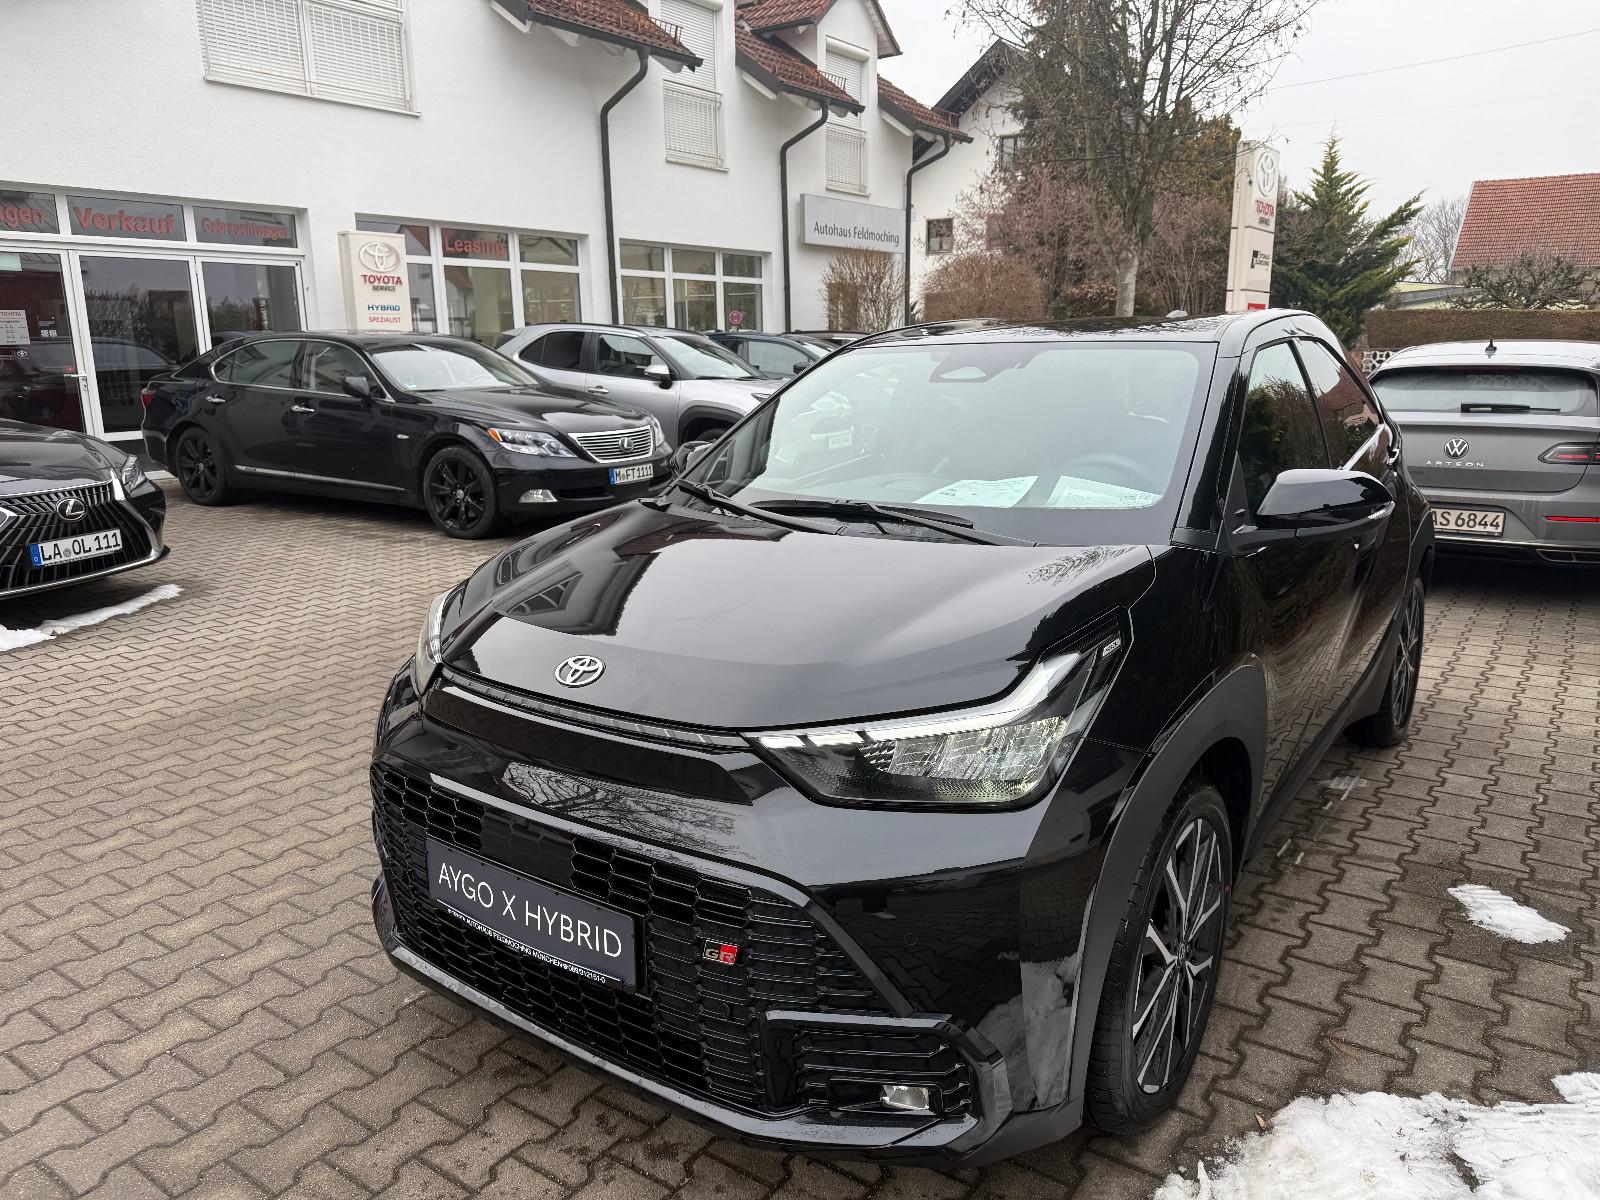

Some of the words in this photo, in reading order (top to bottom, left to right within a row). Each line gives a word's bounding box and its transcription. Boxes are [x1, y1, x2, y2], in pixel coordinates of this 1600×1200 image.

[74, 207, 174, 234] Verkauf
[813, 221, 852, 238] Autohaus
[853, 226, 900, 247] Feldmoching
[444, 232, 505, 258] Leasing
[361, 274, 402, 285] TOYOTA
[367, 304, 401, 312] HYBRID
[625, 467, 636, 480] FT
[637, 465, 652, 477] 1111
[1425, 460, 1484, 468] ARTEON
[1454, 512, 1500, 530] 6844
[41, 543, 62, 561] LA
[72, 538, 91, 555] OL
[94, 532, 121, 550] 111
[438, 862, 494, 908] AYGO
[502, 891, 516, 921] X
[525, 900, 622, 958] HYBRID
[705, 948, 735, 962] GR
